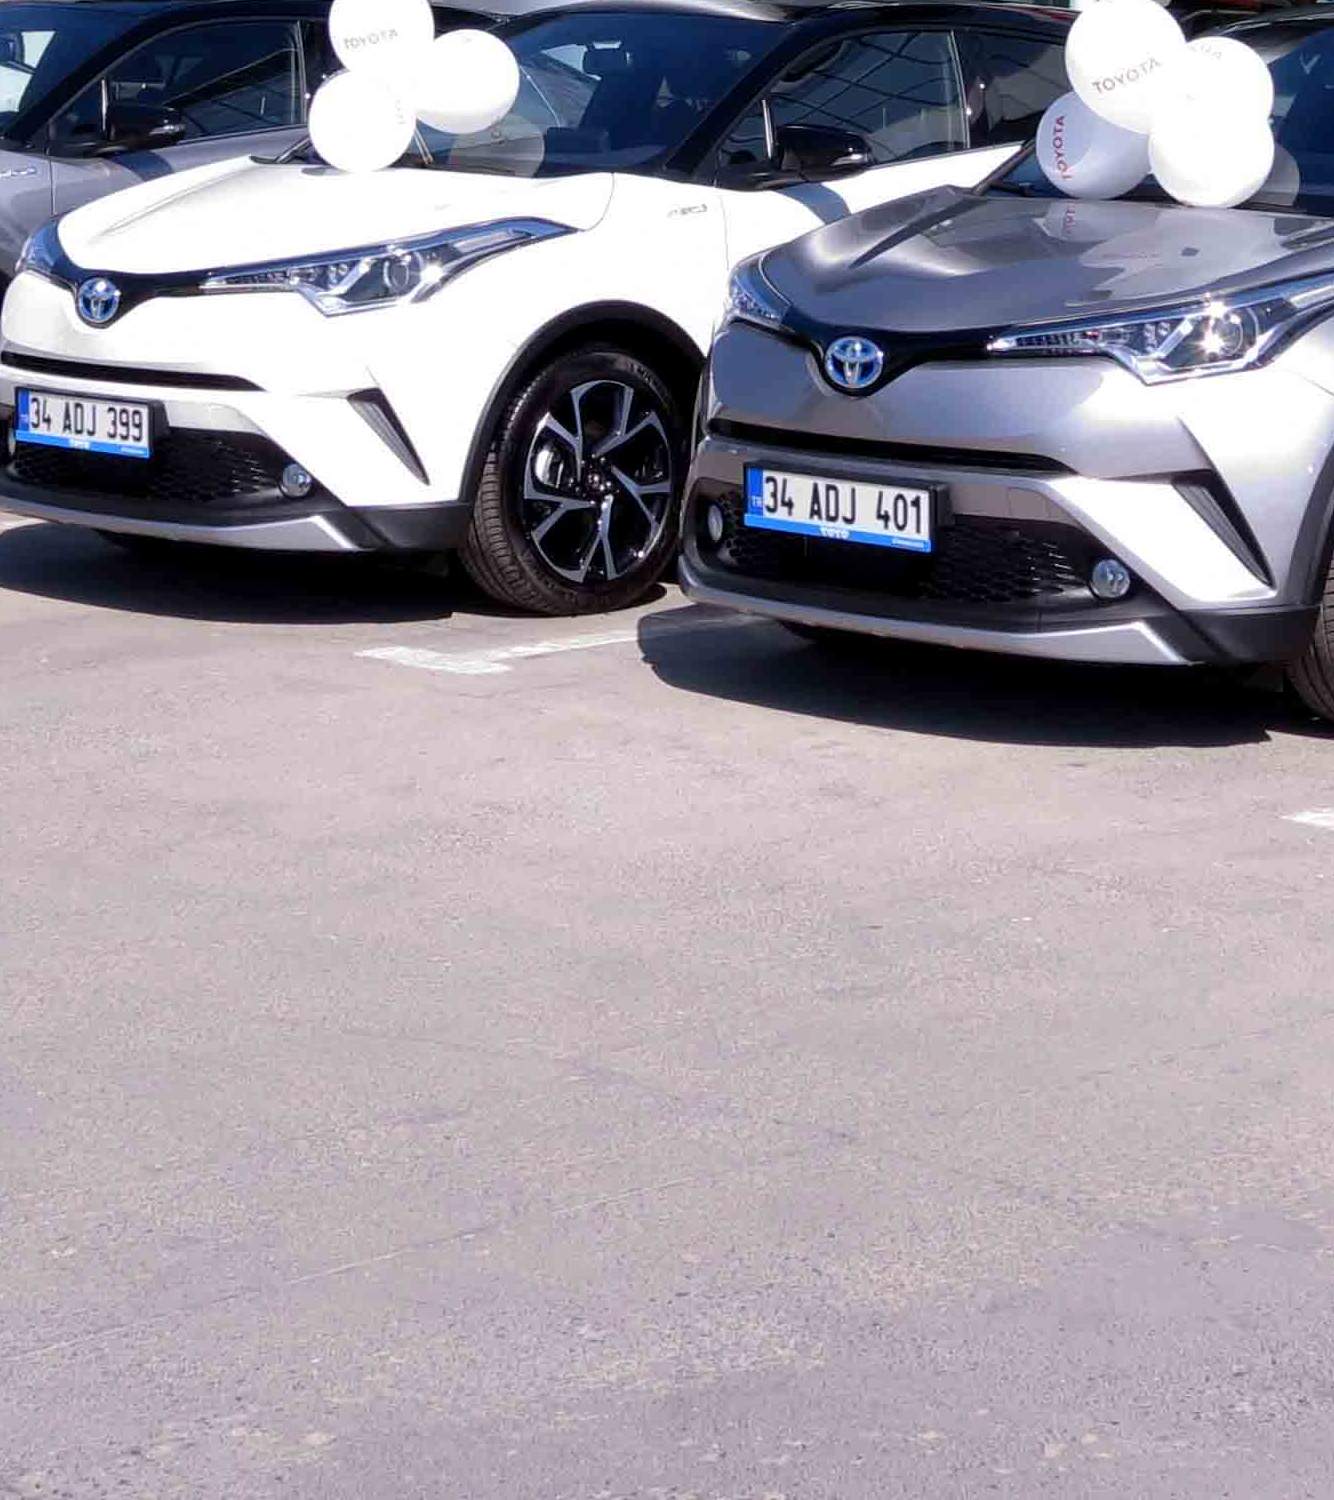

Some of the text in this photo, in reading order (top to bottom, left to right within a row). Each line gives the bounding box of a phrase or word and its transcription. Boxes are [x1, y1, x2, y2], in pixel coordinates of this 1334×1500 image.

[343, 29, 398, 50] TOYOTA
[1091, 57, 1162, 95] TOYOTA
[1052, 115, 1075, 180] TOYOTA
[30, 397, 143, 442] 34 ADJ 399
[764, 475, 922, 534] 34 ADJ 401
